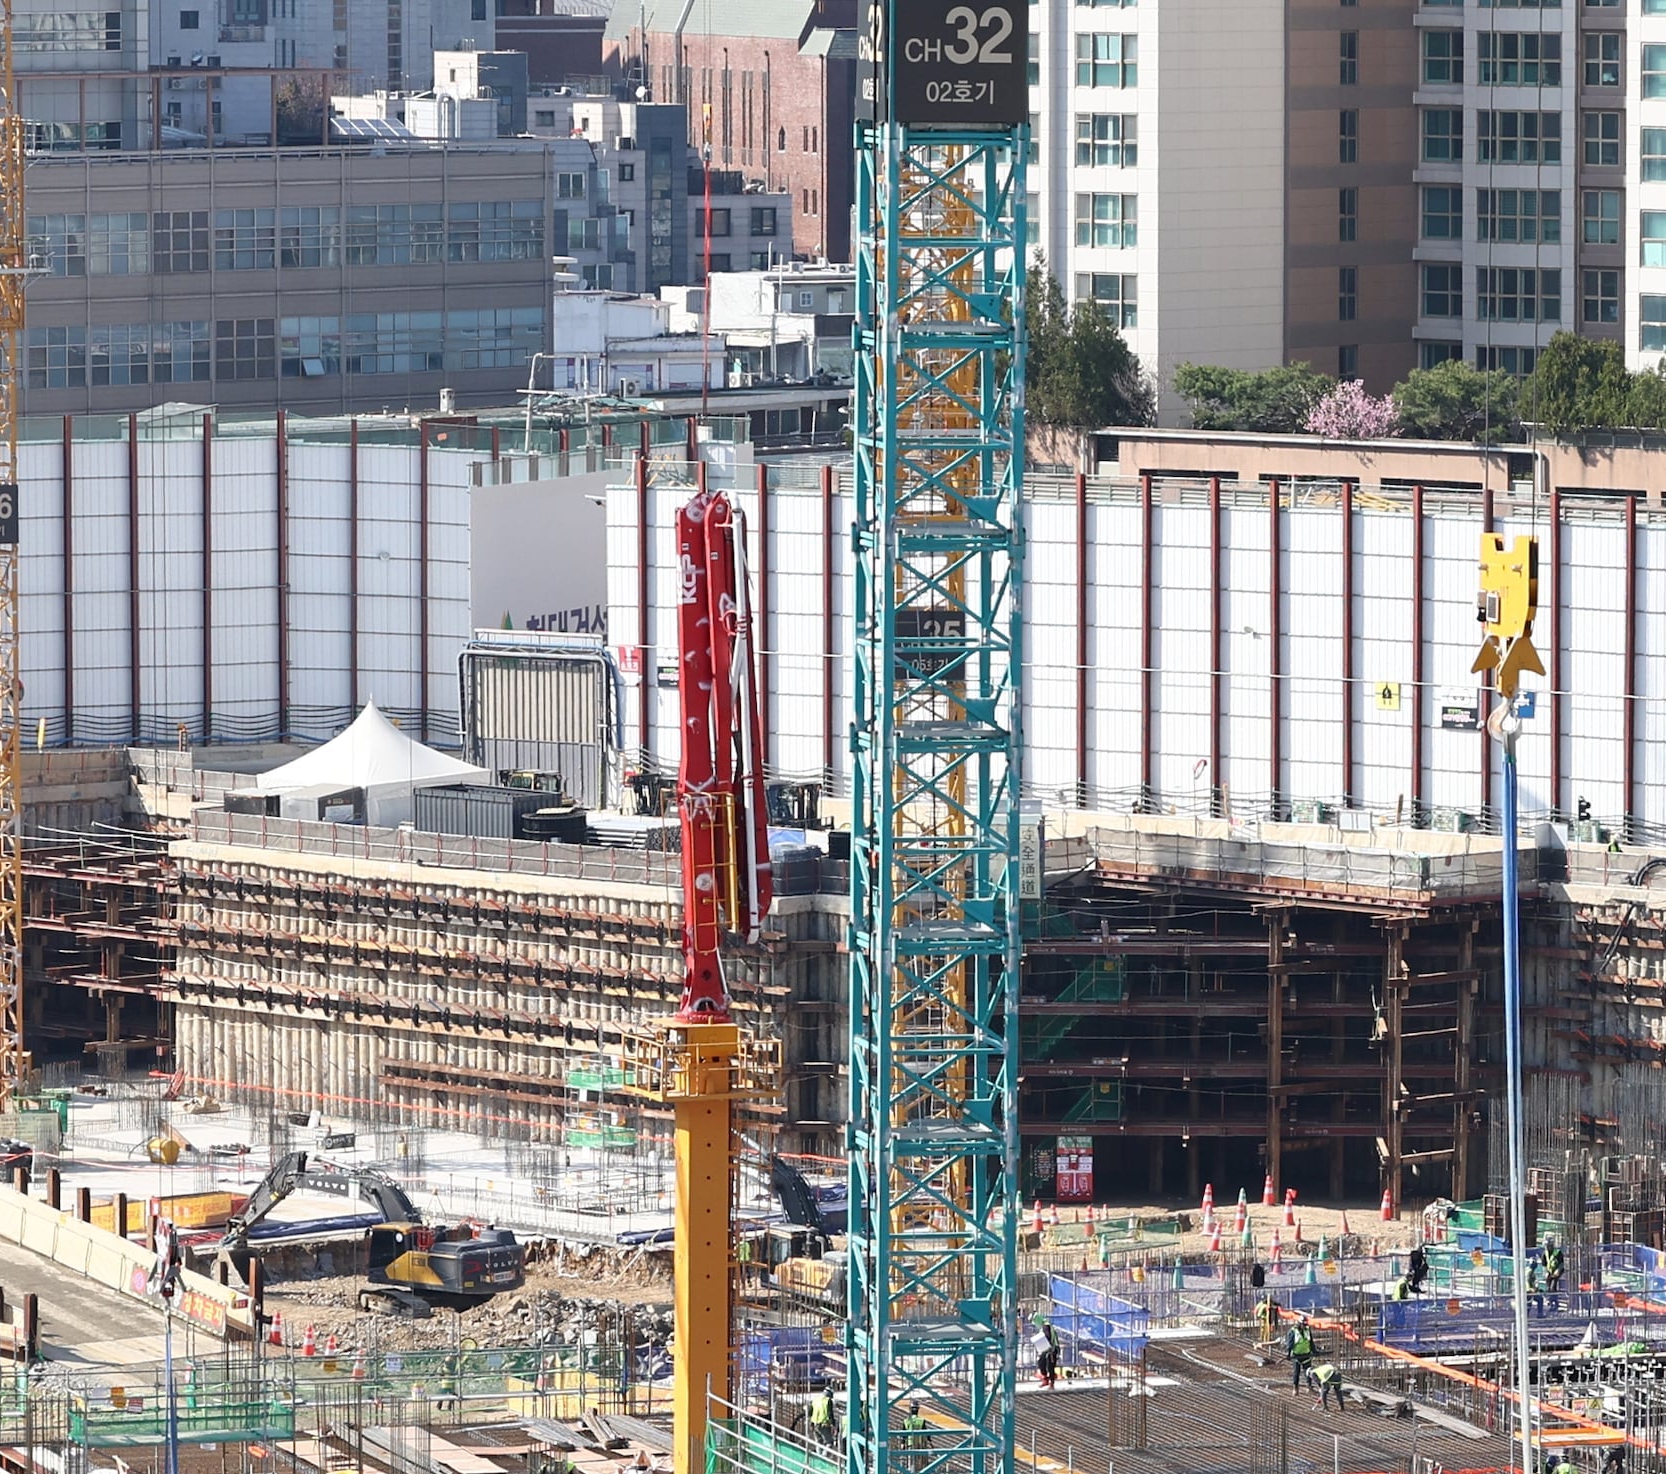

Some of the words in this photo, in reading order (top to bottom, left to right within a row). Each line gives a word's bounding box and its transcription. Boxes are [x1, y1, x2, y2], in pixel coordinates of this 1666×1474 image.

[904, 6, 1013, 65] CH32
[925, 80, 994, 105] 02호기
[681, 553, 697, 604] KCP
[307, 1179, 347, 1191] VOLVO
[485, 1258, 519, 1268] VOLVO
